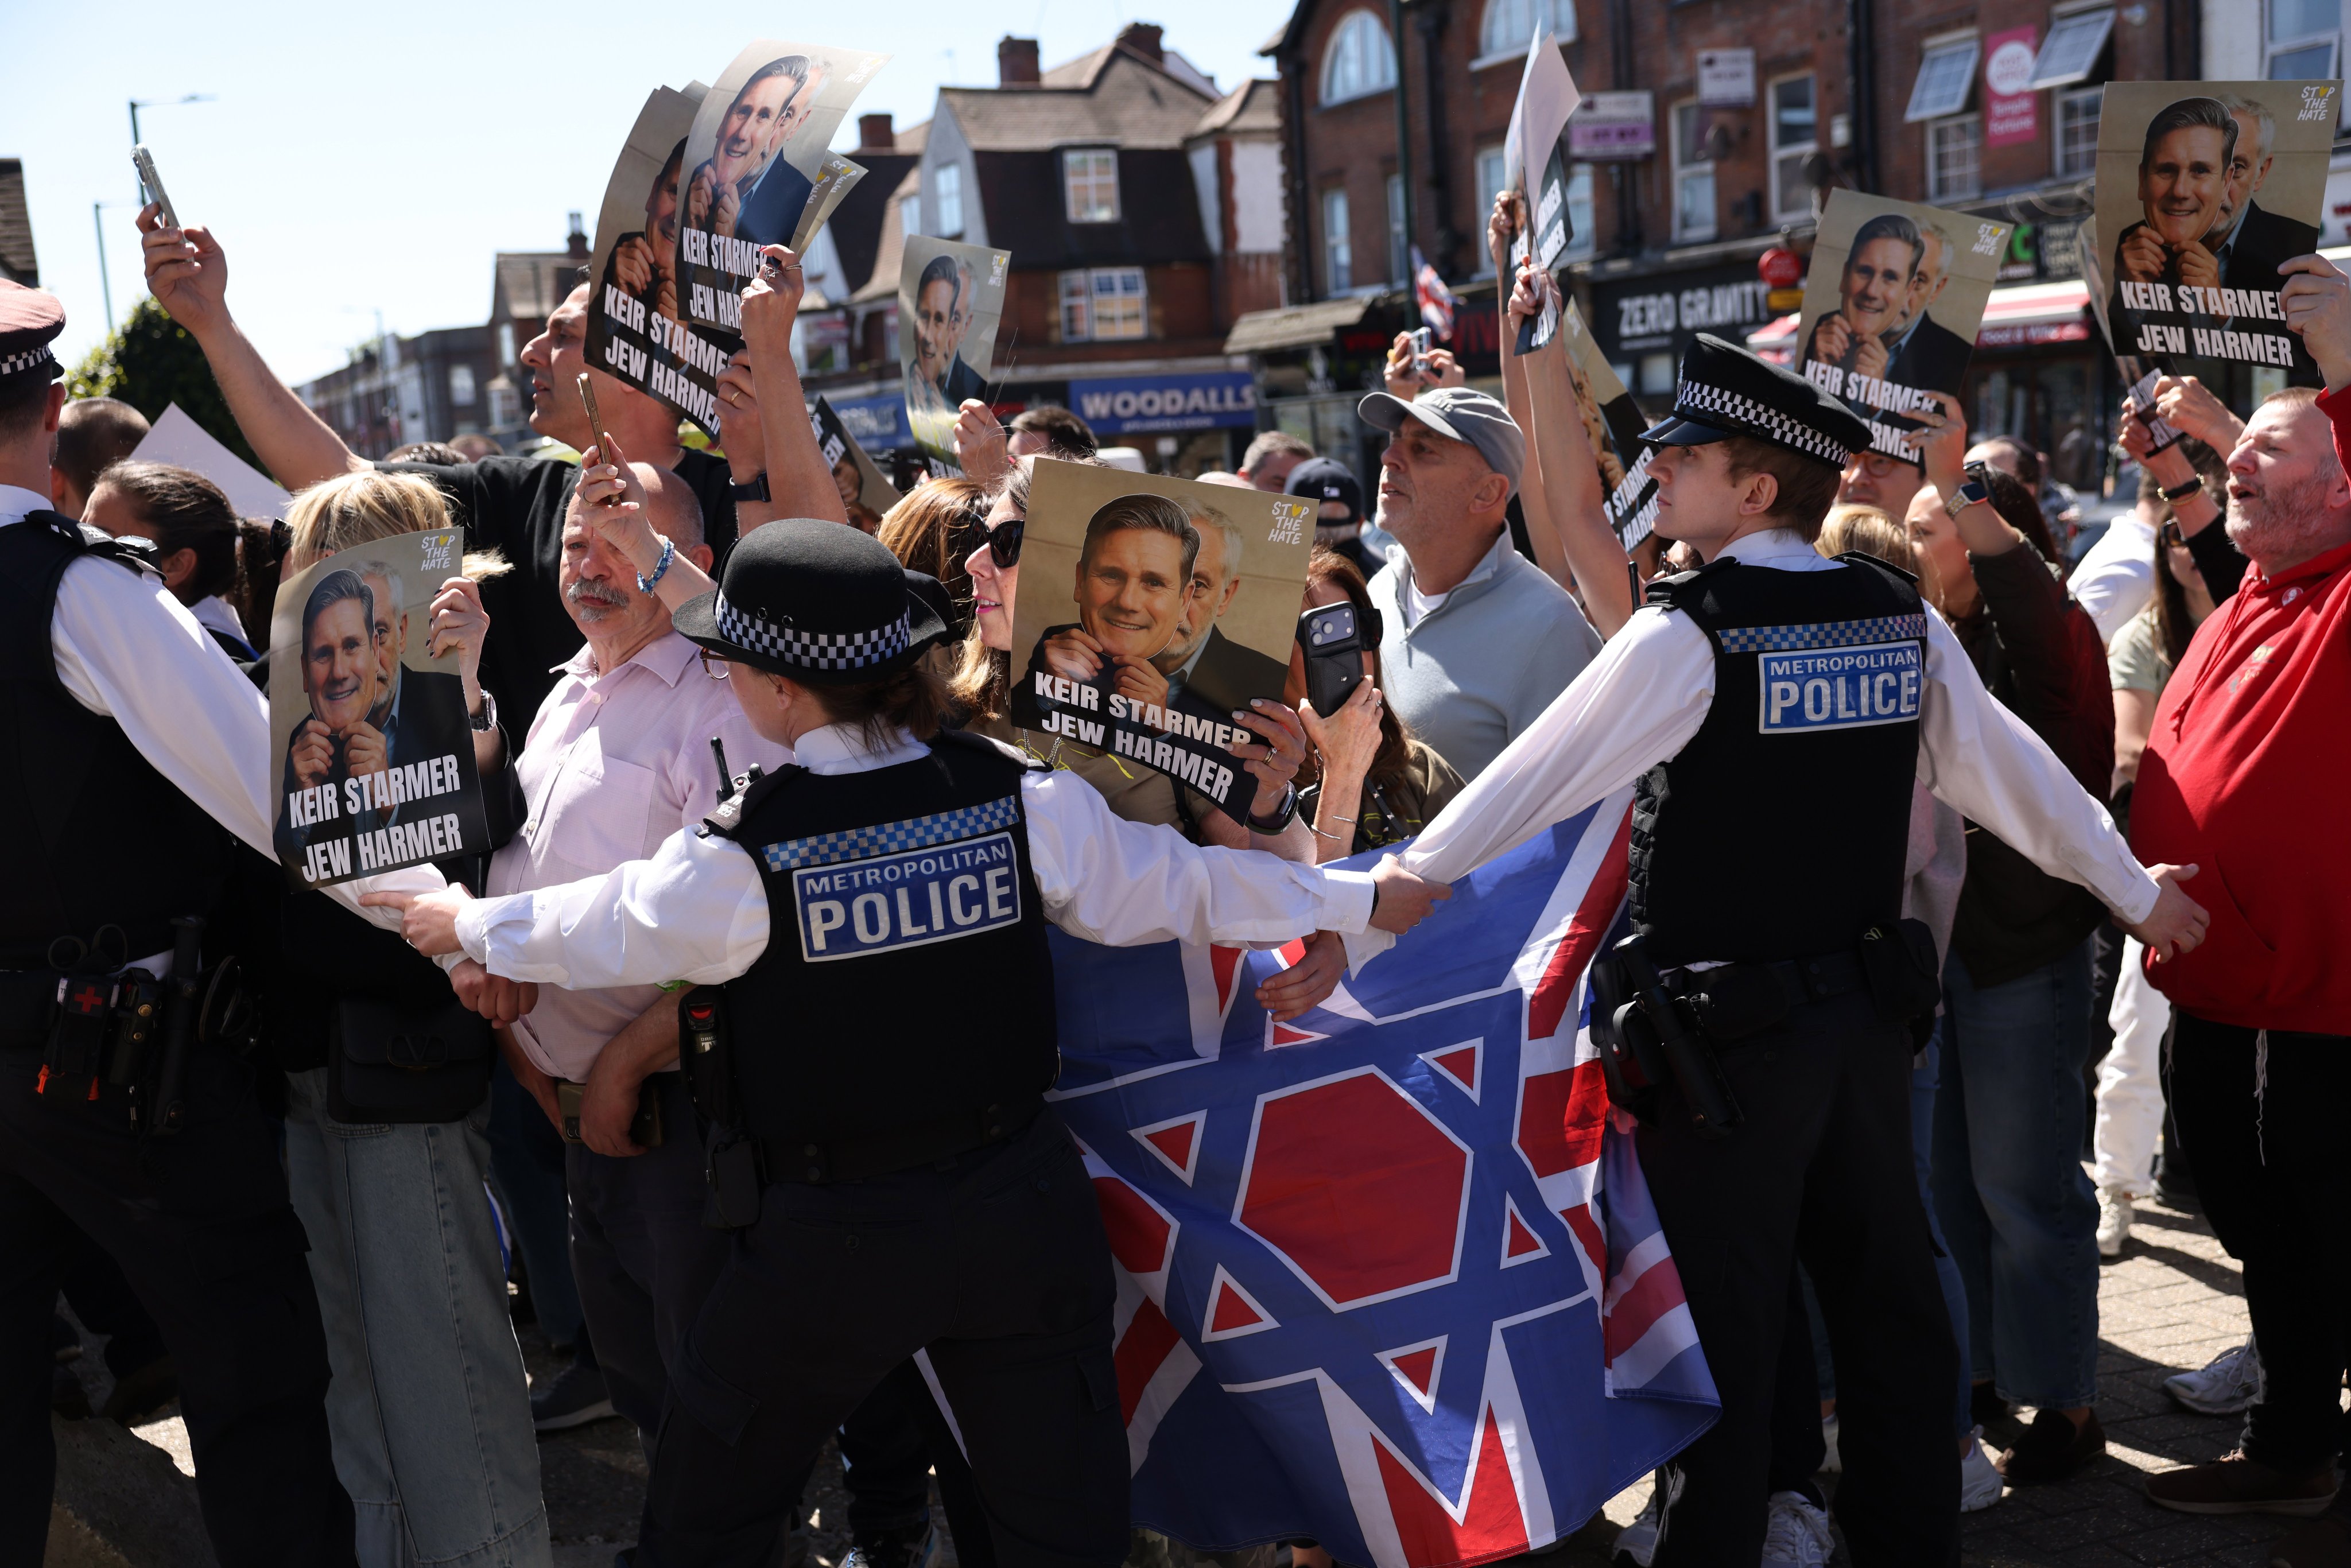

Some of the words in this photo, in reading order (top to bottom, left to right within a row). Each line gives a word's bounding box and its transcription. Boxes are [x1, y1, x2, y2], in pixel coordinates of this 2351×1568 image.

[2297, 109, 2328, 121] HATE
[2304, 98, 2329, 110] THE
[683, 227, 709, 267] KEIR
[1971, 242, 1997, 255] HATE
[1979, 235, 1999, 247] THE
[689, 283, 715, 322] JEW
[1617, 292, 1677, 337] ZERO
[1679, 280, 1771, 330] GRAVITY
[2120, 281, 2174, 312] KEIR
[604, 283, 646, 335] KEIR
[650, 311, 732, 379] STARME
[2136, 324, 2187, 355] JEW
[2192, 328, 2294, 367] HARMER
[605, 335, 648, 383] JEW
[1081, 384, 1256, 420] WOODALLS
[1846, 371, 1938, 414] STARMER
[1268, 529, 1302, 545] HATE
[1275, 516, 1302, 531] THE
[421, 557, 451, 572] HATE
[425, 546, 450, 559] THE
[1771, 650, 1917, 676] METROPOLITAN
[1035, 671, 1099, 712] KEIR
[1770, 670, 1917, 724] POLICE
[1042, 711, 1105, 746] JEW
[1115, 729, 1233, 804] HARMER
[289, 783, 339, 829] KEIR
[344, 754, 460, 814] STARMER
[301, 837, 351, 883] JEW
[357, 813, 463, 871] HARMER
[806, 843, 1007, 895] METROPOLITAN
[808, 866, 1012, 951] POLICE
